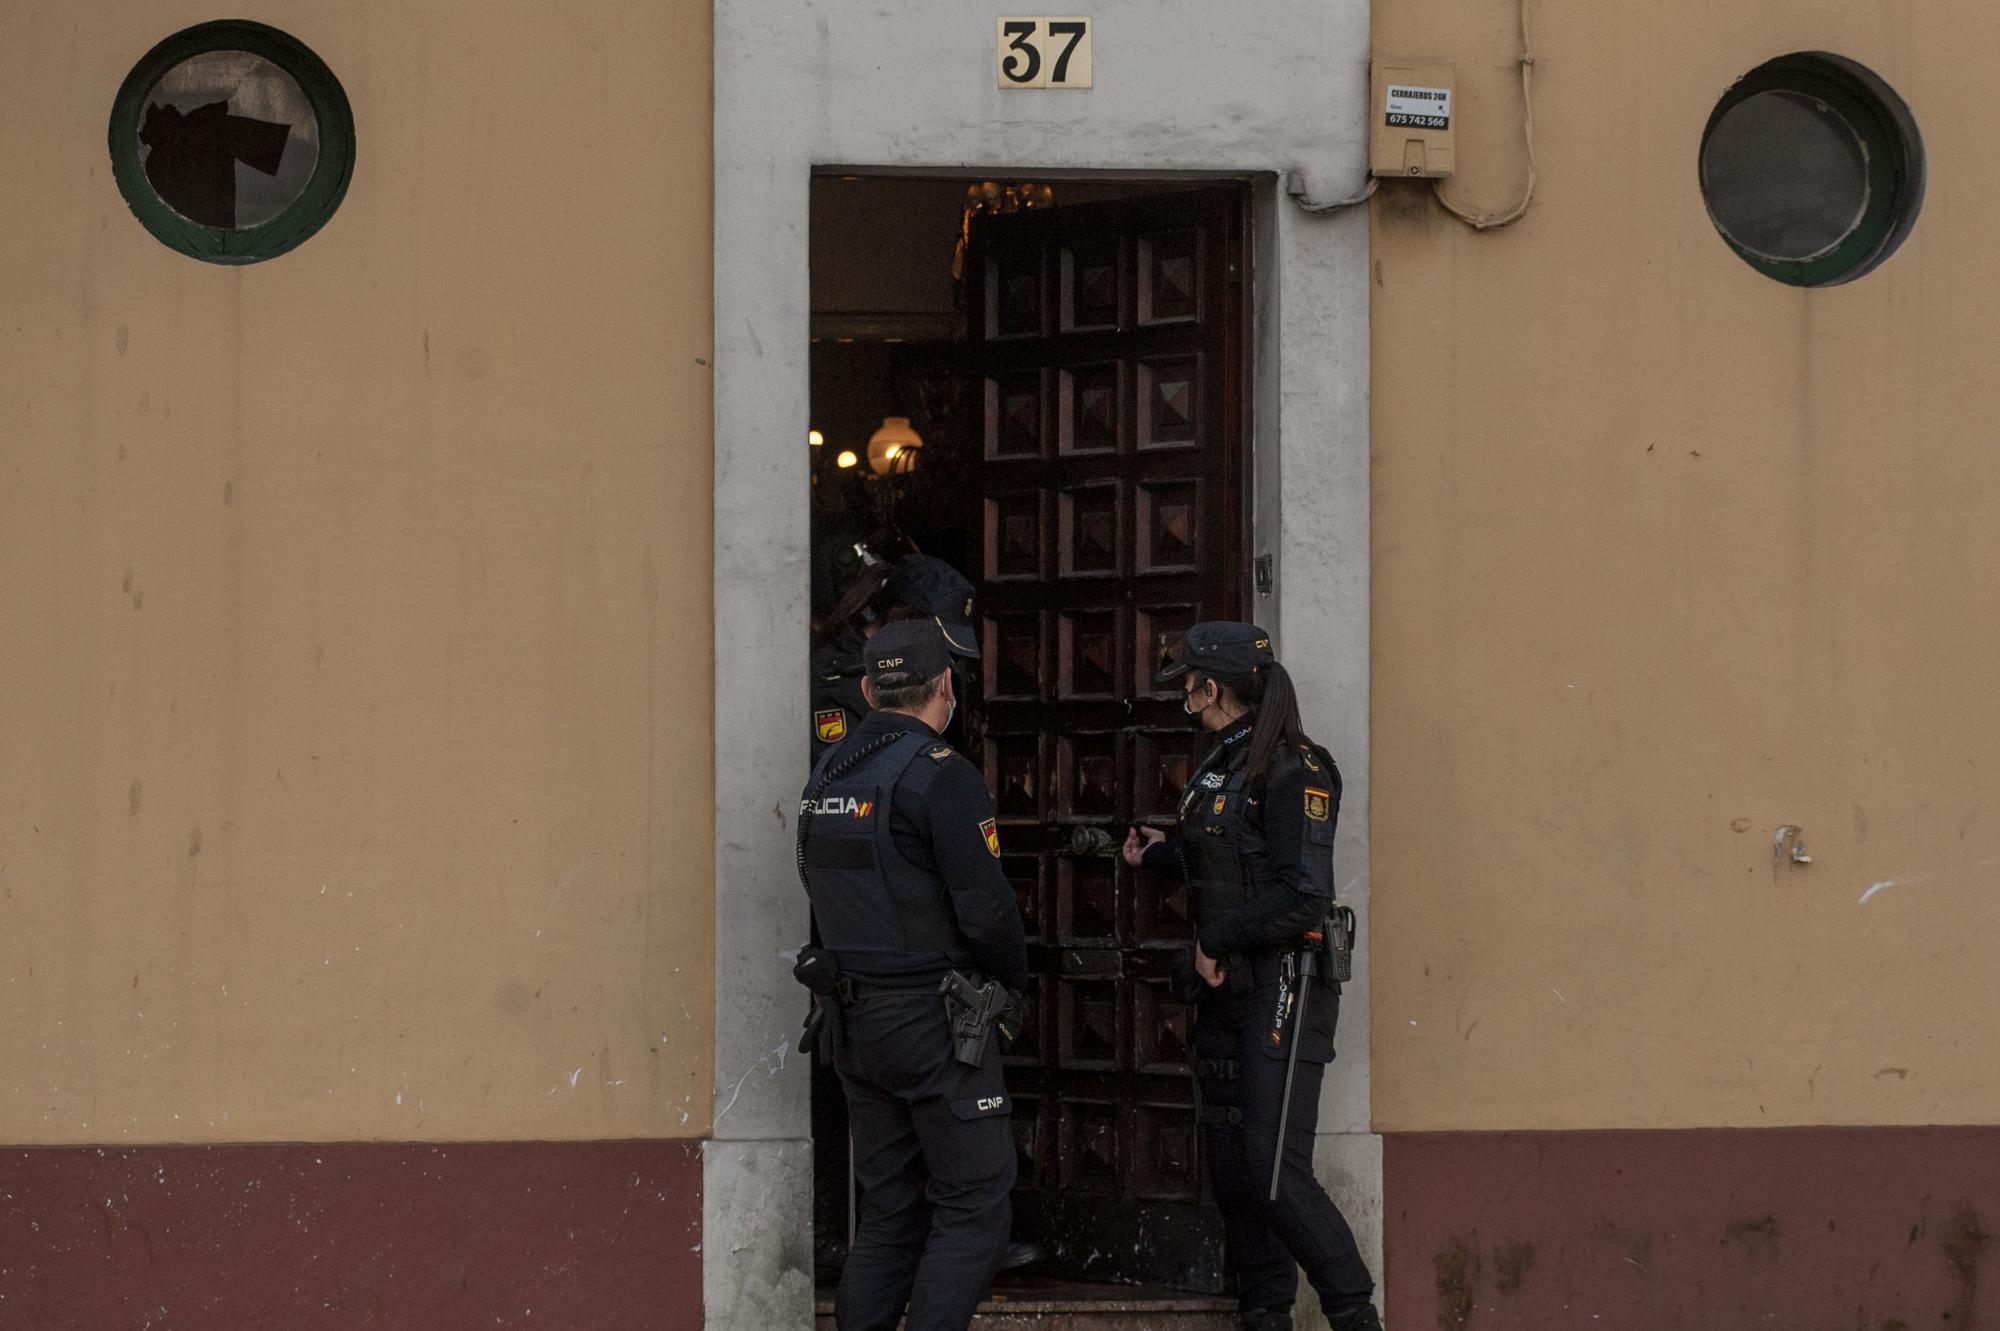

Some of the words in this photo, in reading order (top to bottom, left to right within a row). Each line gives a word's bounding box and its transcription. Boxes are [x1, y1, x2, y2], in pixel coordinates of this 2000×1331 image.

[1002, 21, 1086, 83] 37
[1391, 89, 1432, 100] CERRAJEROS
[1390, 115, 1407, 124] 675
[1409, 116, 1426, 125] 742
[1427, 117, 1445, 127] 566
[877, 658, 904, 669] CNP
[799, 796, 860, 816] PLICIA
[977, 1096, 1004, 1111] CNP
